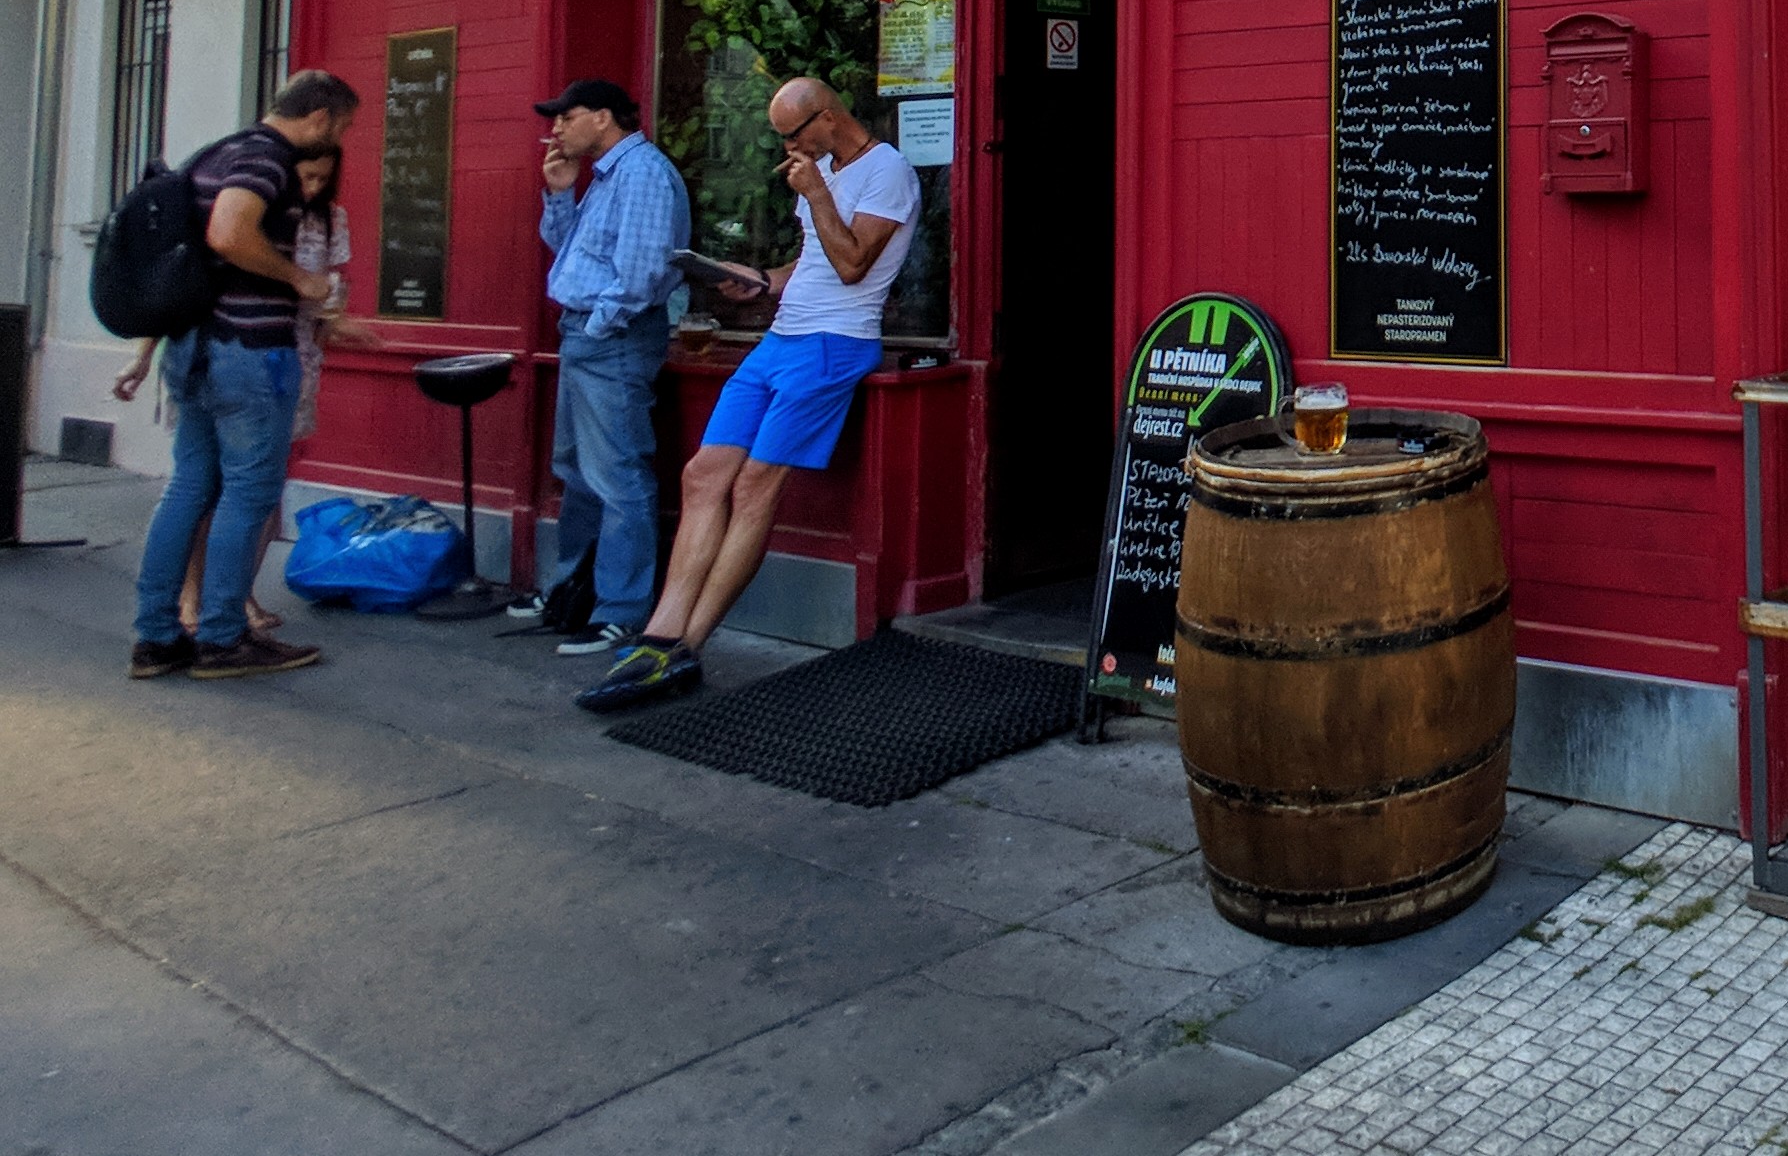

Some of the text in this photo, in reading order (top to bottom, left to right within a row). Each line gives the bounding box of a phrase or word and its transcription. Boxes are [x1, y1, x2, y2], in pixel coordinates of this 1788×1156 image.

[1396, 297, 1435, 311] TANKOVÝ
[1384, 329, 1446, 342] STAROPRAMEN
[1150, 346, 1227, 374] U PĚTNÍKA
[1133, 413, 1185, 439] dejrest.cz
[1152, 674, 1176, 696] kofol
